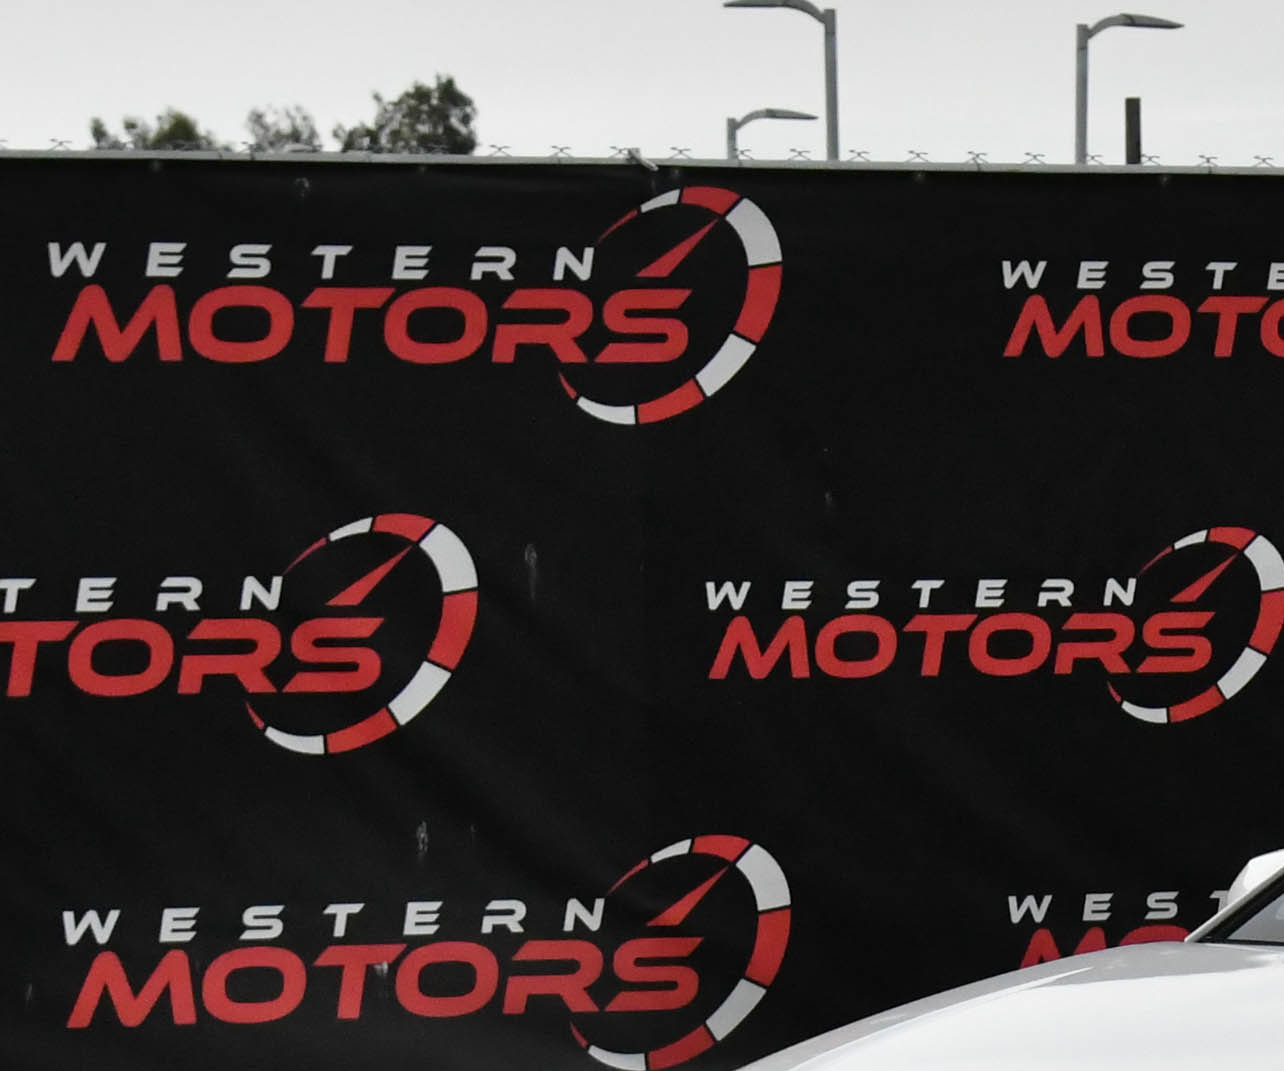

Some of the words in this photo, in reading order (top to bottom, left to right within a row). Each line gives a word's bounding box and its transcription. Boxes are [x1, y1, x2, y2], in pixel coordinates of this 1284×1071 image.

[49, 242, 594, 281] WESTERN
[52, 285, 692, 363] MOTORS
[705, 577, 1137, 611] WESTERN
[709, 611, 1215, 680] MOTORS
[62, 898, 605, 946] WESTERN
[67, 937, 703, 1028] MOTORS
